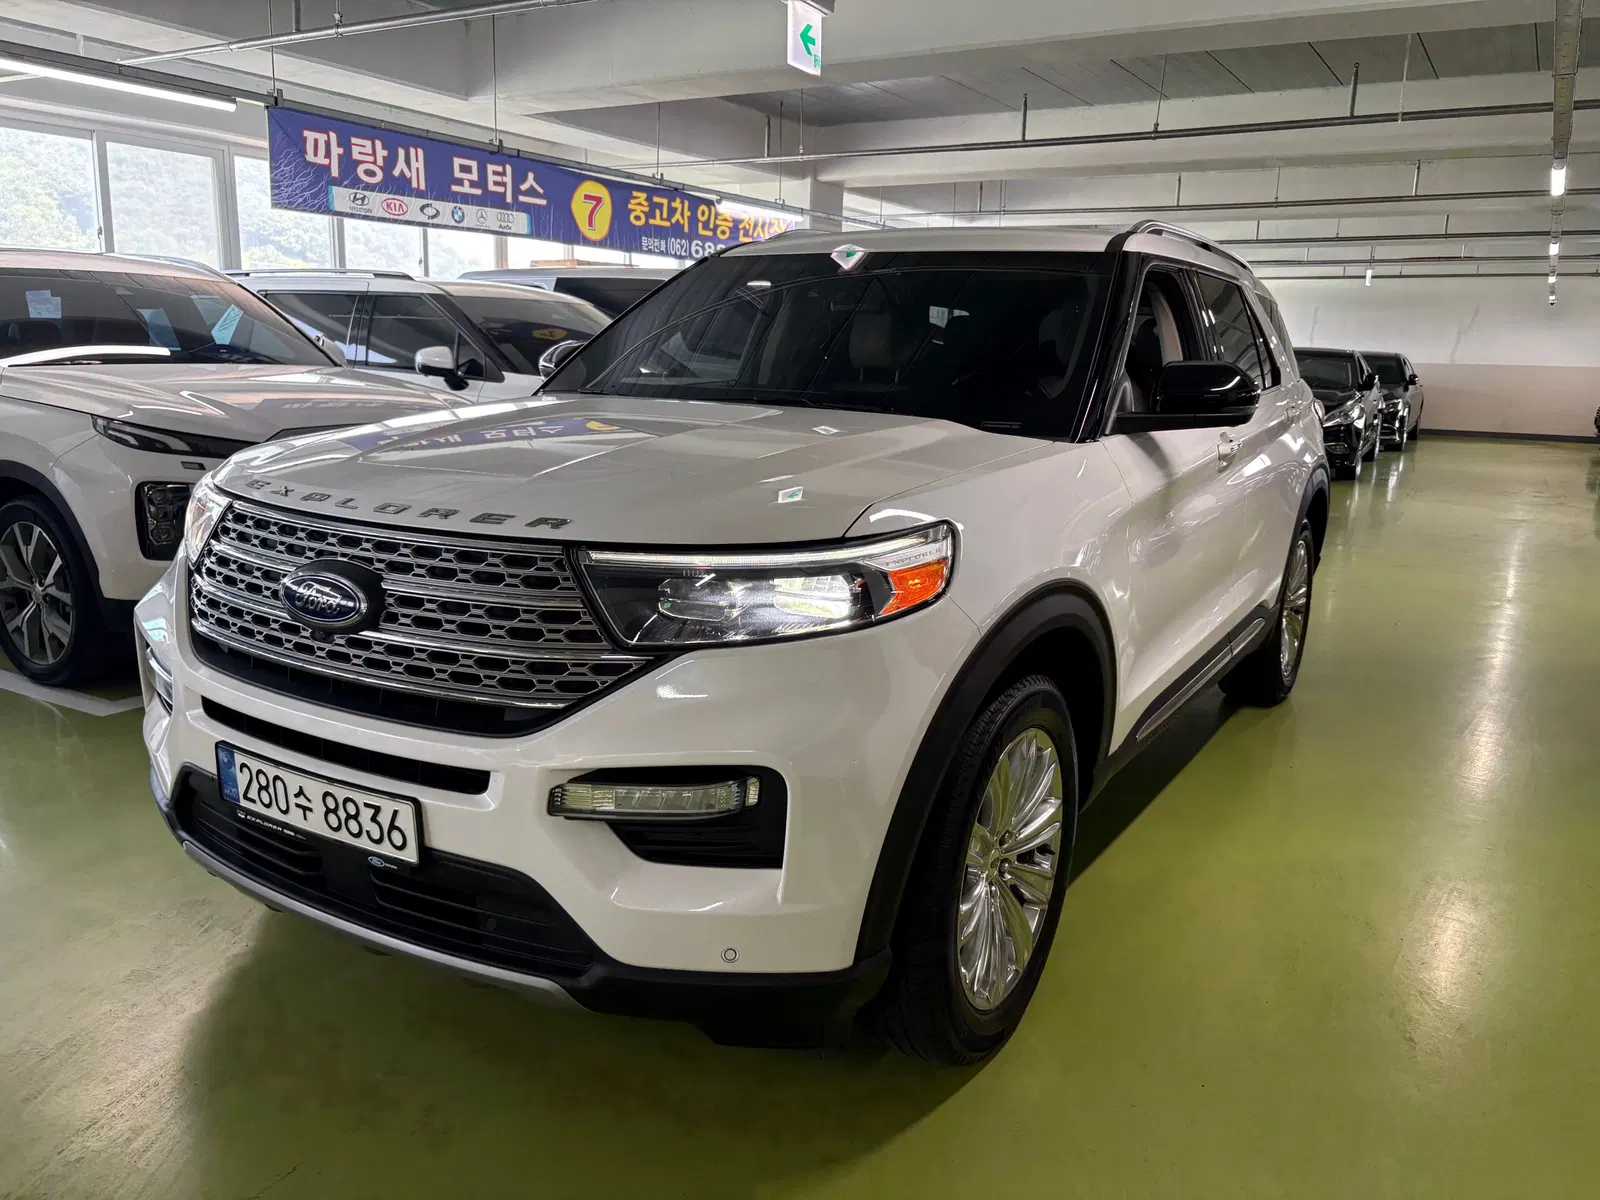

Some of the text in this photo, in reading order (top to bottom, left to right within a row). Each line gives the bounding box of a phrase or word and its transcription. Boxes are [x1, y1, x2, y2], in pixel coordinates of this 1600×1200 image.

[303, 129, 547, 206] 파랑새 모터스
[385, 201, 405, 213] KIA
[583, 193, 604, 231] 7
[627, 190, 691, 233] 중고차
[697, 203, 734, 240] 인증
[641, 236, 667, 253] 문의전화
[667, 236, 689, 256] (062)
[244, 478, 573, 530] EXPLORER
[295, 581, 342, 615] Ford
[239, 761, 408, 851] 280수 8836
[246, 815, 283, 832] EXPLORER
